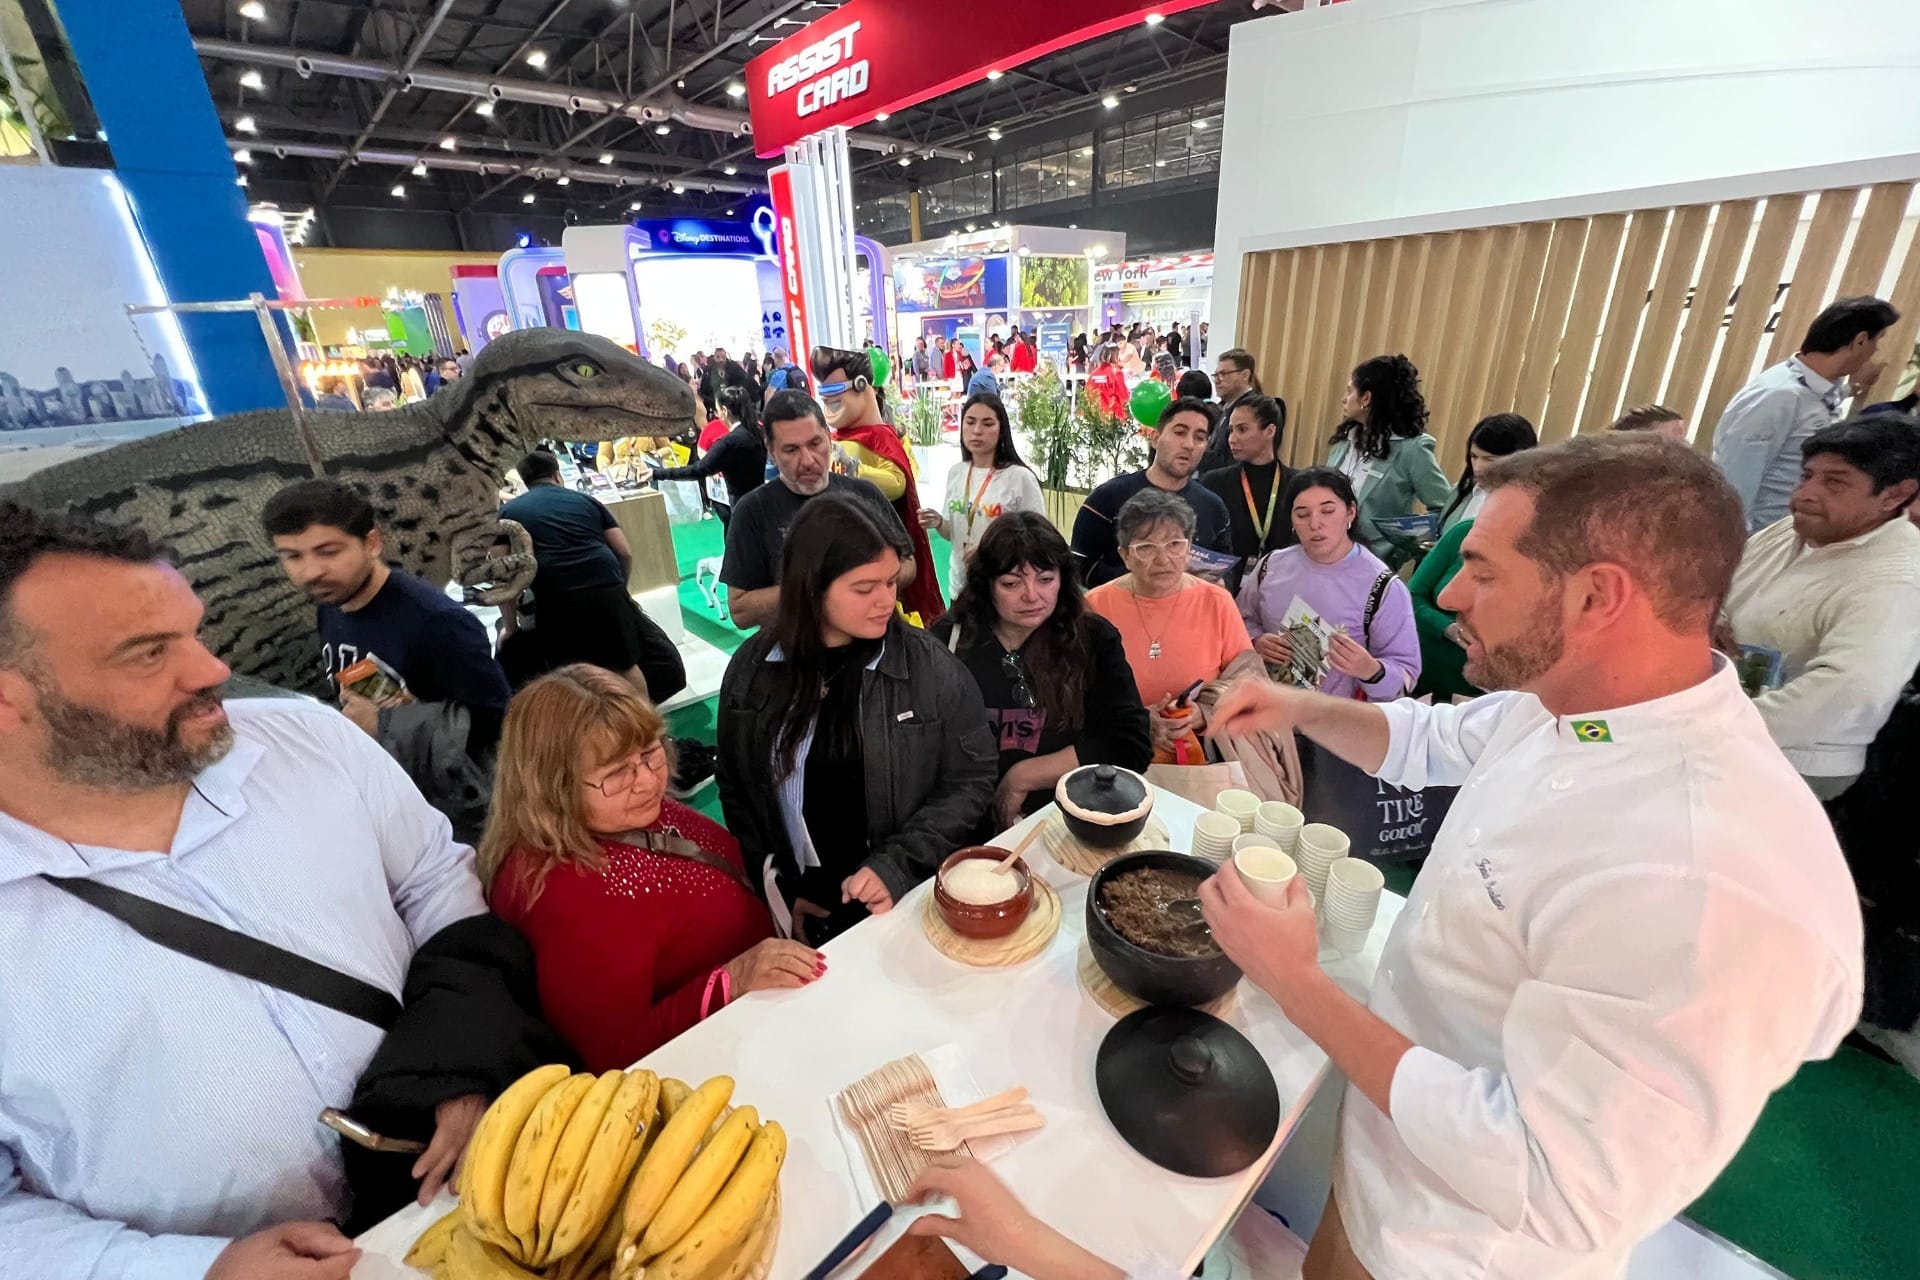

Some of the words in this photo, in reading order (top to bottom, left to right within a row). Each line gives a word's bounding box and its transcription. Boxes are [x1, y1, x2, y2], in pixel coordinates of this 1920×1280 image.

[768, 20, 861, 98] ASSIST
[797, 59, 869, 117] CARD
[671, 231, 700, 246] Disney
[1094, 270, 1112, 282] ew
[1118, 264, 1149, 281] York
